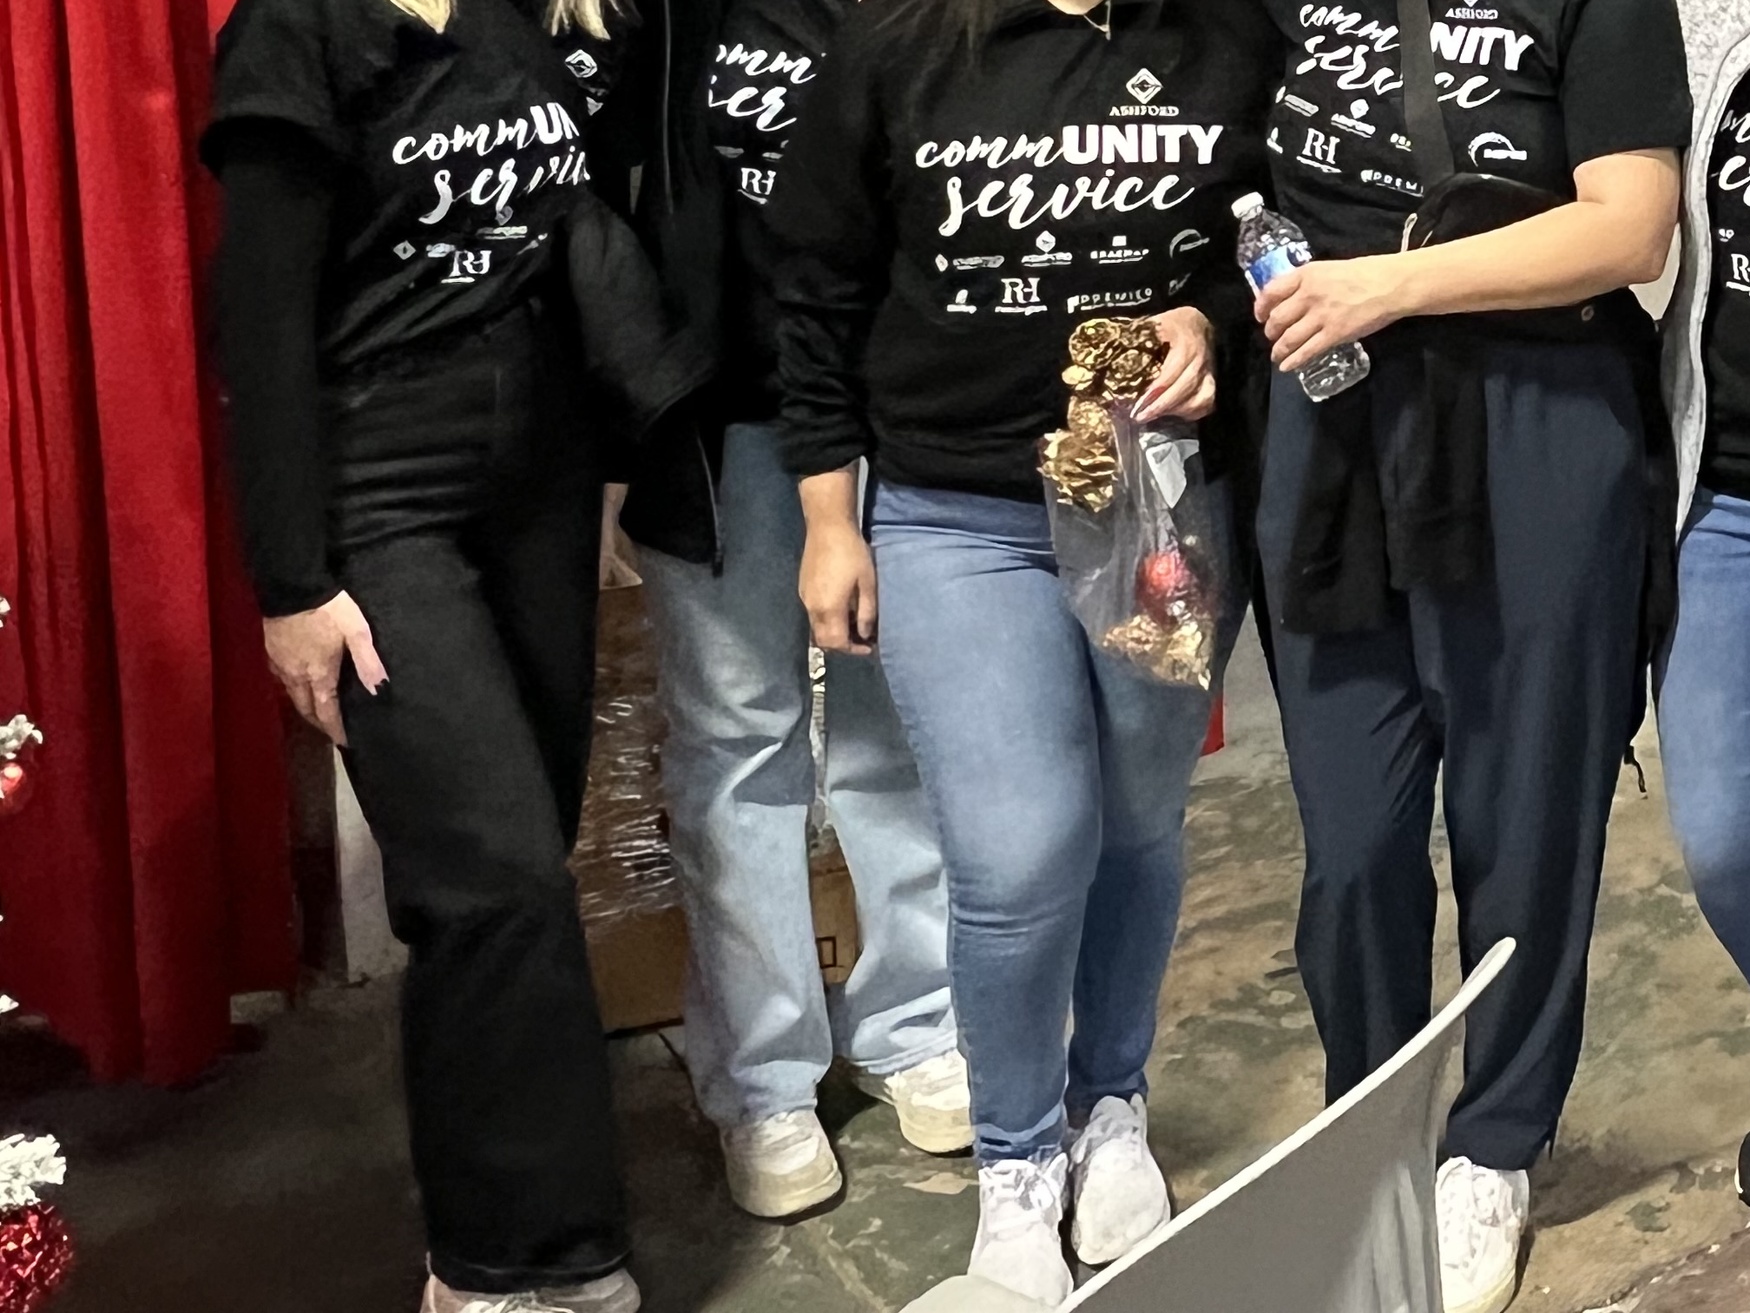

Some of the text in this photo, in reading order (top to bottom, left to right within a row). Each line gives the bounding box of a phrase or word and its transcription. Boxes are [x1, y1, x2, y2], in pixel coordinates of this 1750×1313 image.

[915, 124, 1225, 169] commUNITY
[938, 169, 1196, 237] service
[1001, 277, 1042, 305] RH
